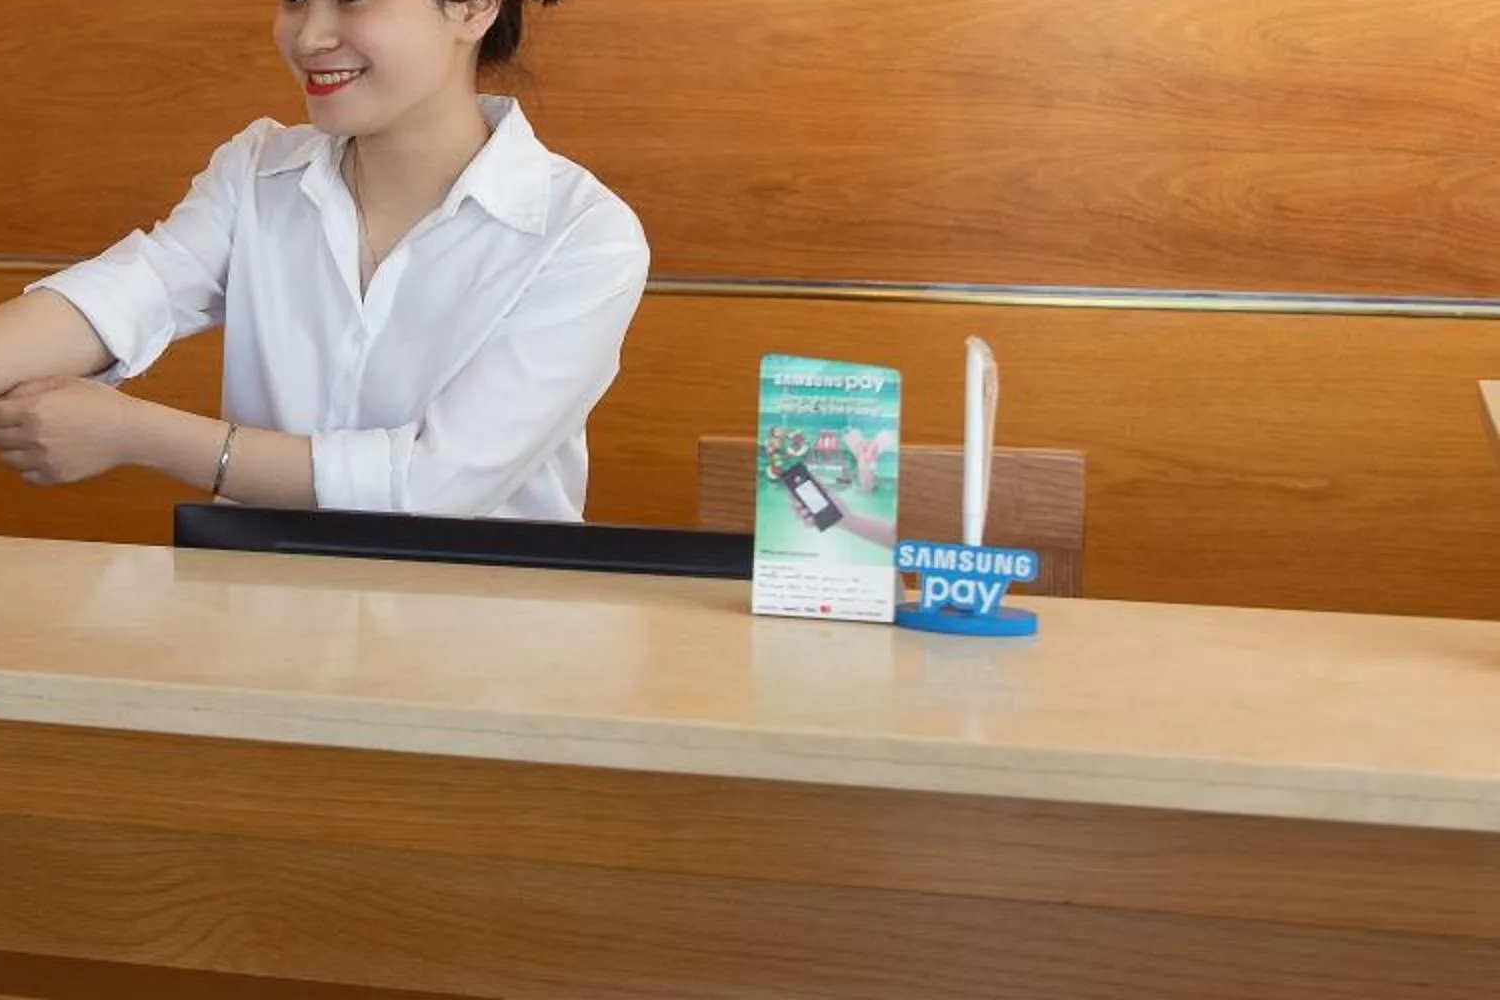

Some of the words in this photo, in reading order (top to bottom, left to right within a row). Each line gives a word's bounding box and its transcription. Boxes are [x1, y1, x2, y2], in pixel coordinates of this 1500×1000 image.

[845, 375, 885, 393] pay
[899, 545, 1033, 577] SAMSUNG
[922, 575, 1003, 614] pay
